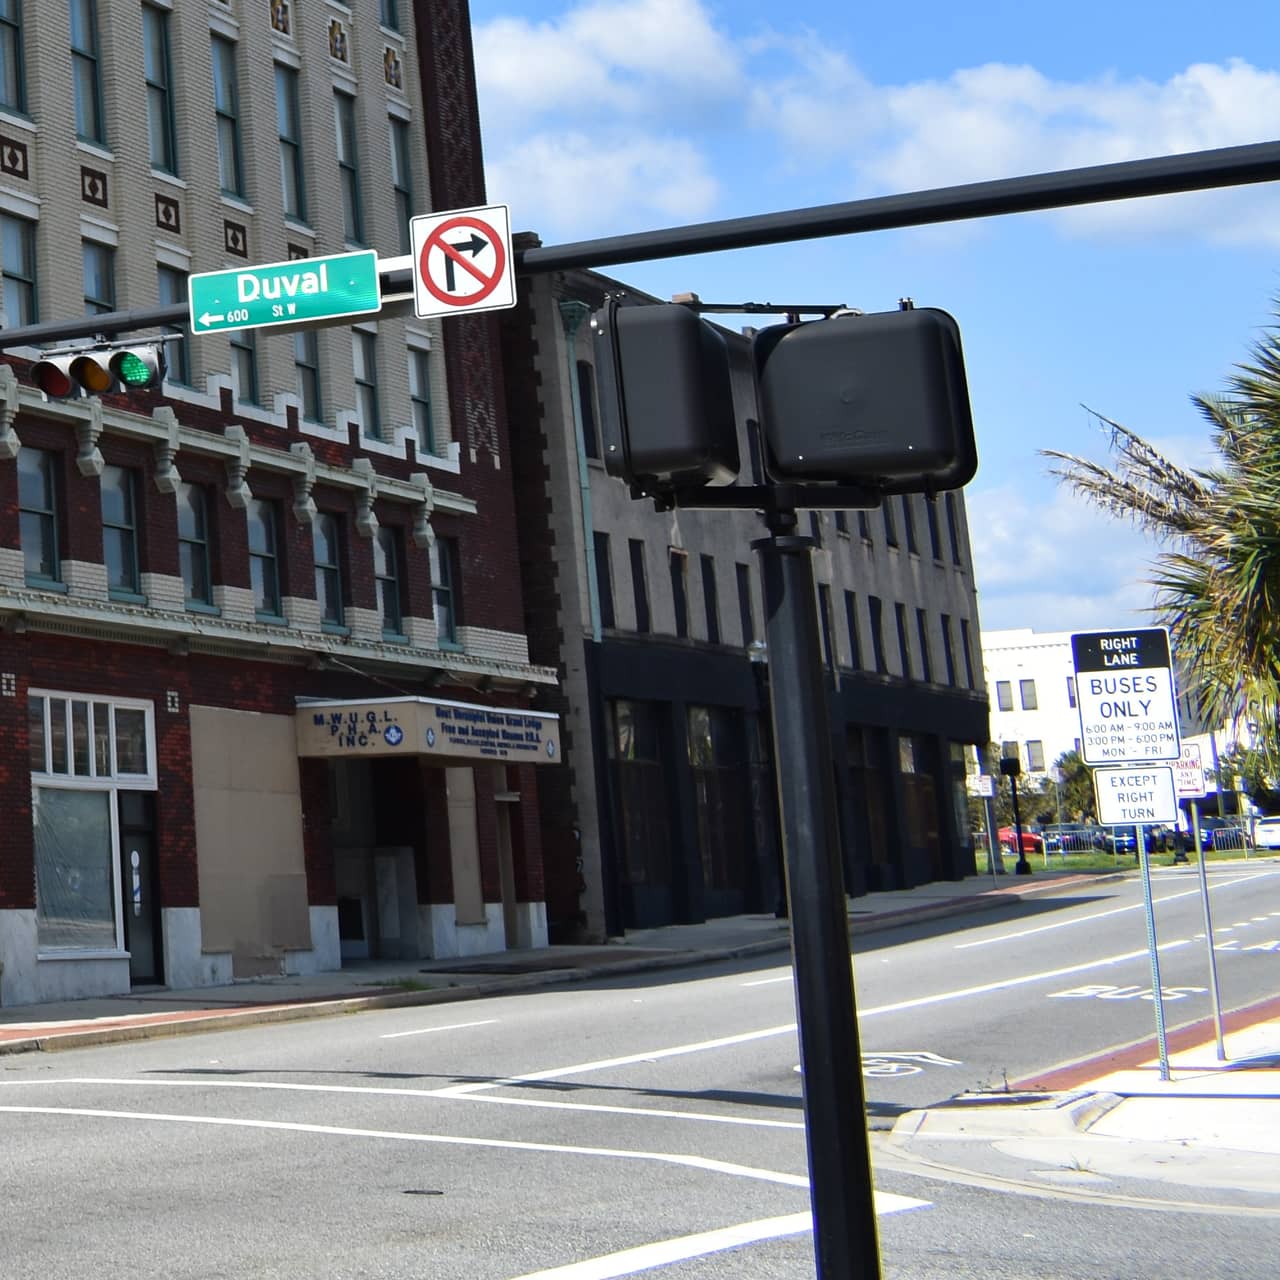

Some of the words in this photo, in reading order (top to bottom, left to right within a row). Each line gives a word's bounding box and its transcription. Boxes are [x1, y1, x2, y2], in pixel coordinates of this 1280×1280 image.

[237, 263, 328, 303] Duval
[226, 309, 248, 323] 600
[272, 304, 284, 317] St
[287, 303, 296, 315] W
[1100, 637, 1138, 651] RIGHT
[1103, 653, 1139, 667] LANE
[1090, 675, 1158, 696] BUSES
[1100, 699, 1152, 719] ONLY
[313, 710, 398, 726] M.W.U.G.L.
[1085, 724, 1107, 734] 6:00
[1110, 723, 1125, 733] AM
[1134, 722, 1156, 731] 9:00
[1158, 721, 1173, 730] AM
[338, 736, 376, 747] INC.
[1087, 736, 1109, 746] 3:00
[1111, 735, 1125, 745] PM
[1136, 734, 1158, 744] 6:00
[1159, 733, 1175, 743] PM
[1102, 748, 1126, 757] MON
[1145, 746, 1163, 755] FRI
[1110, 775, 1158, 788] EXCEPT
[1117, 791, 1155, 803] RIGHT
[1121, 807, 1156, 819] TURN
[1046, 984, 1209, 1001] BUS
